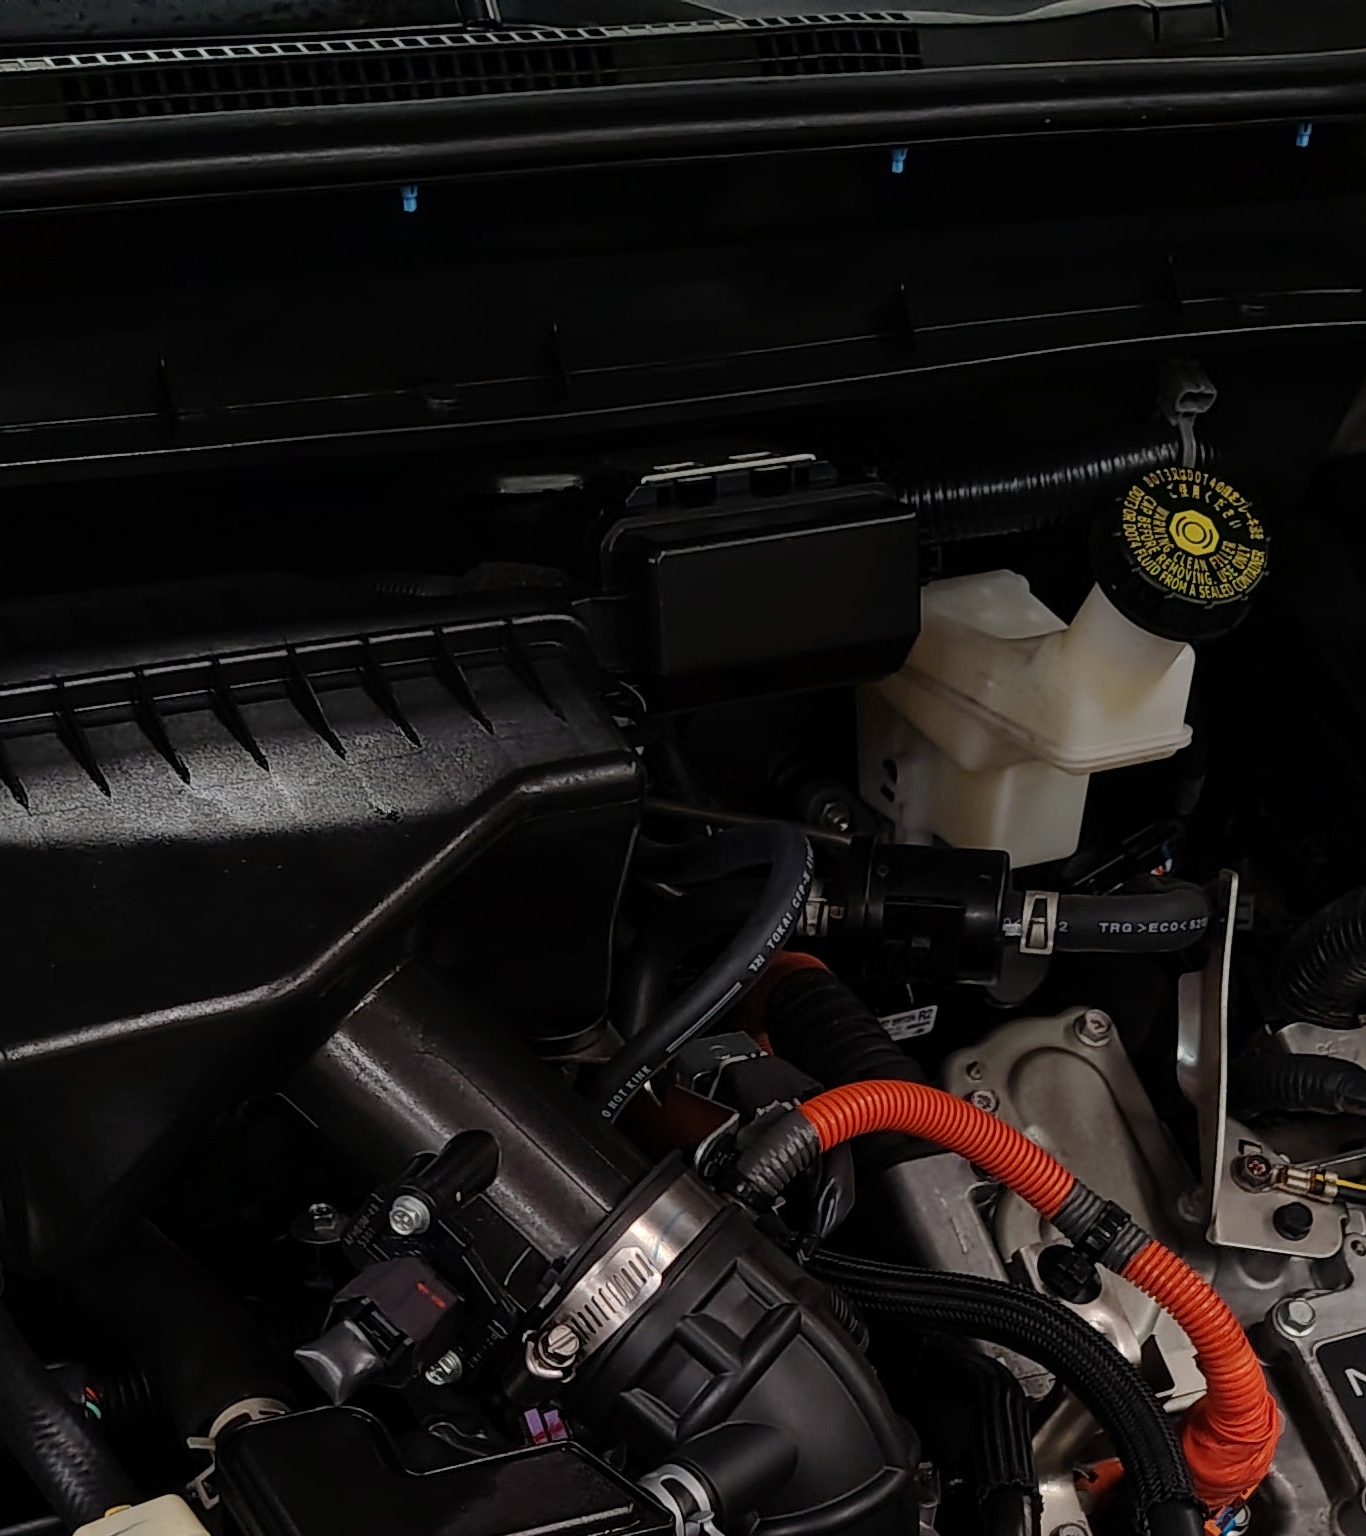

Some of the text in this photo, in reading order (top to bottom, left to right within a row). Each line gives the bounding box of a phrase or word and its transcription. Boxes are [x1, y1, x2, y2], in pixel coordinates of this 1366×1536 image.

[1122, 485, 1265, 599] DOT3 OR DOT4 FLUID FROM A SEALED CONTAINER
[1137, 495, 1251, 585] CAP BEFORE REMOVING. USE ONLY
[1153, 506, 1175, 553] WARNING
[1173, 551, 1208, 571] CLEAN
[766, 911, 793, 949] TOKAI
[625, 1064, 652, 1090] KINK
